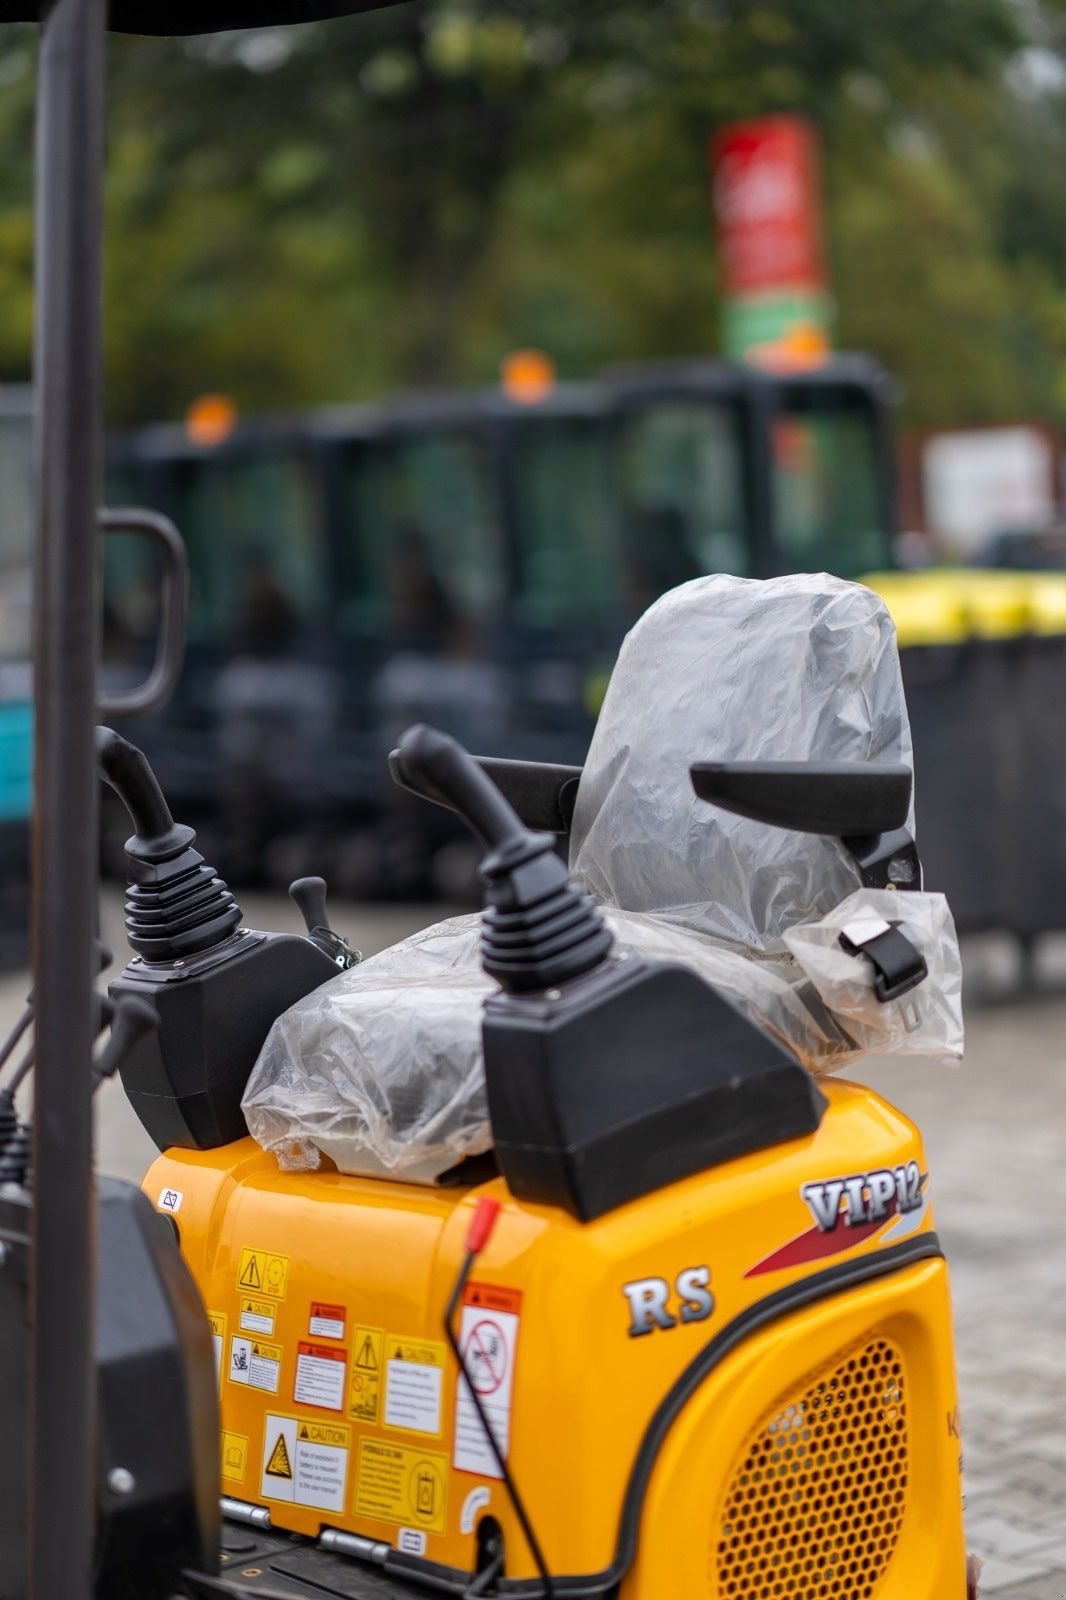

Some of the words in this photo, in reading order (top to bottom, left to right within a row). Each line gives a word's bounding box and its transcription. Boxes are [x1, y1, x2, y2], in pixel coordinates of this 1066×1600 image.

[802, 1160, 923, 1234] VIP12
[623, 1265, 715, 1338] RS
[311, 1426, 346, 1443] CAUTION
